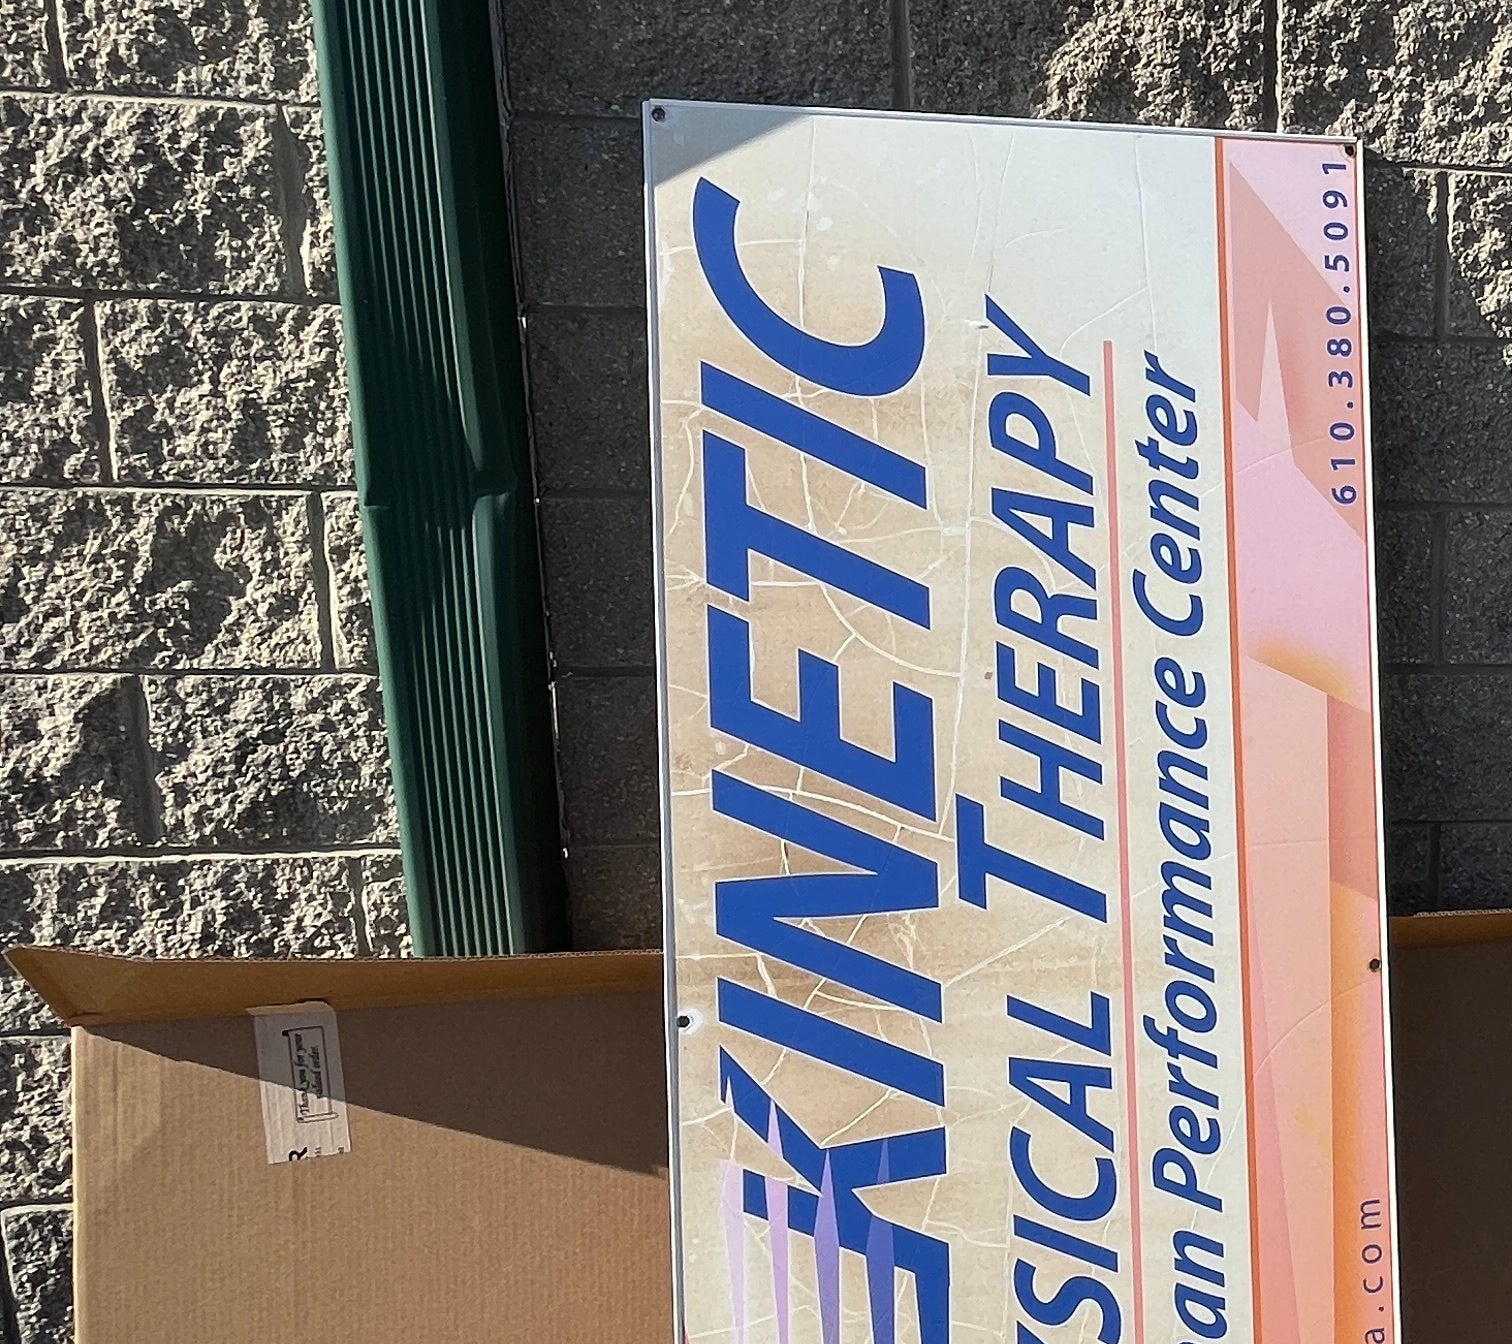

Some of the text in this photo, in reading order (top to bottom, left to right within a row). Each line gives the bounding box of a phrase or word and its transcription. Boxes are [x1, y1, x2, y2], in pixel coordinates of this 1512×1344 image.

[956, 299, 1107, 921] THERAPY
[1132, 354, 1204, 636] Center
[1321, 162, 1357, 505] 610.380.5091
[691, 179, 949, 1296] KINETIC
[1143, 658, 1222, 1211] Performance
